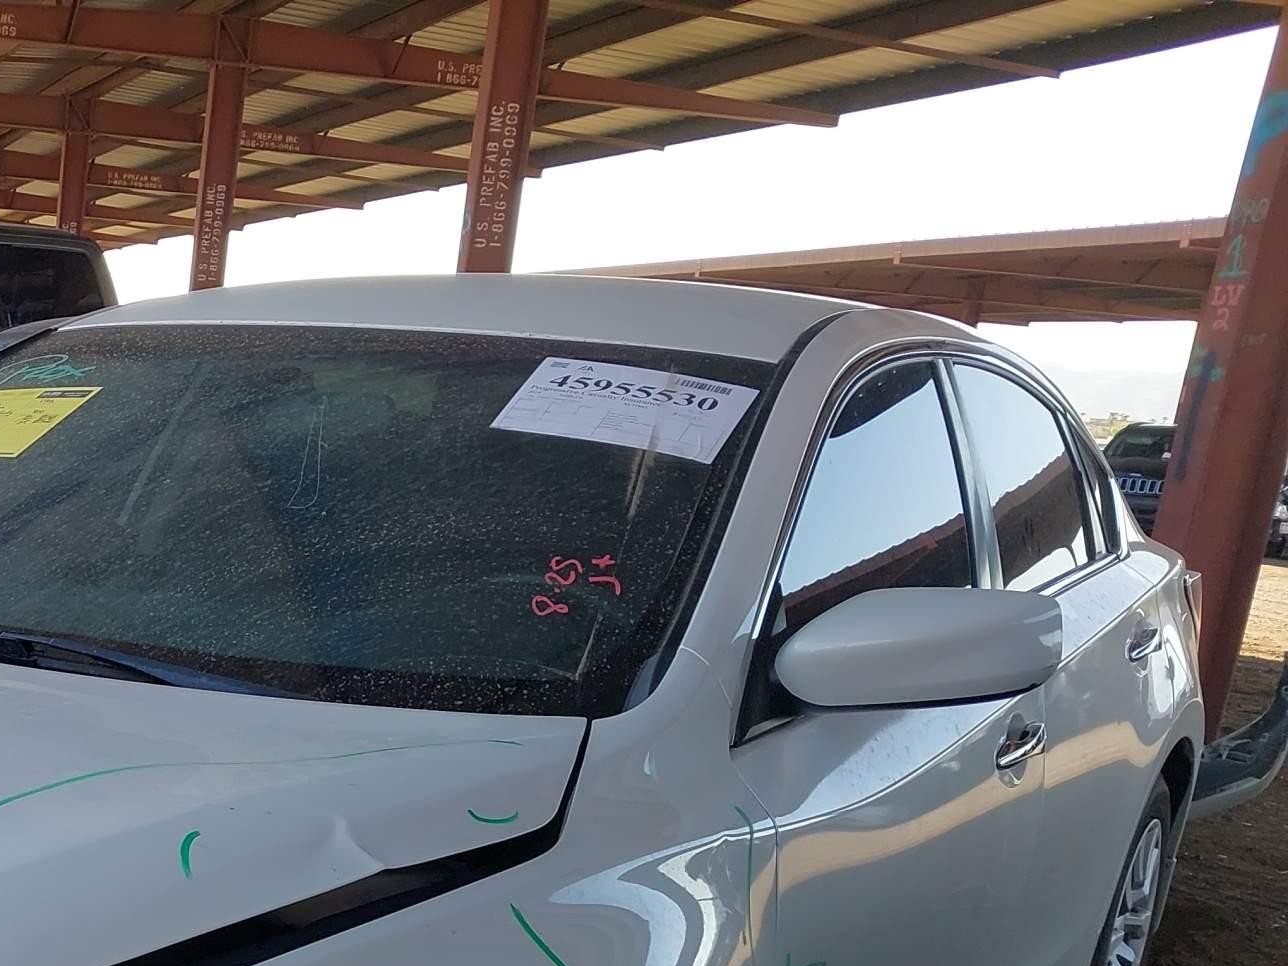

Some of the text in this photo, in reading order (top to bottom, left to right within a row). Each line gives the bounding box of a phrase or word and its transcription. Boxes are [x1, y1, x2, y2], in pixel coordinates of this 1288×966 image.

[437, 59, 484, 75] U.S. PRE
[489, 100, 506, 132] INC.
[479, 142, 500, 207] PREFAB
[489, 102, 521, 247] 1-866-799-0969
[200, 210, 213, 254] PREFAB
[208, 184, 227, 281] 1-866-799-0969
[549, 374, 720, 411] 45955530
